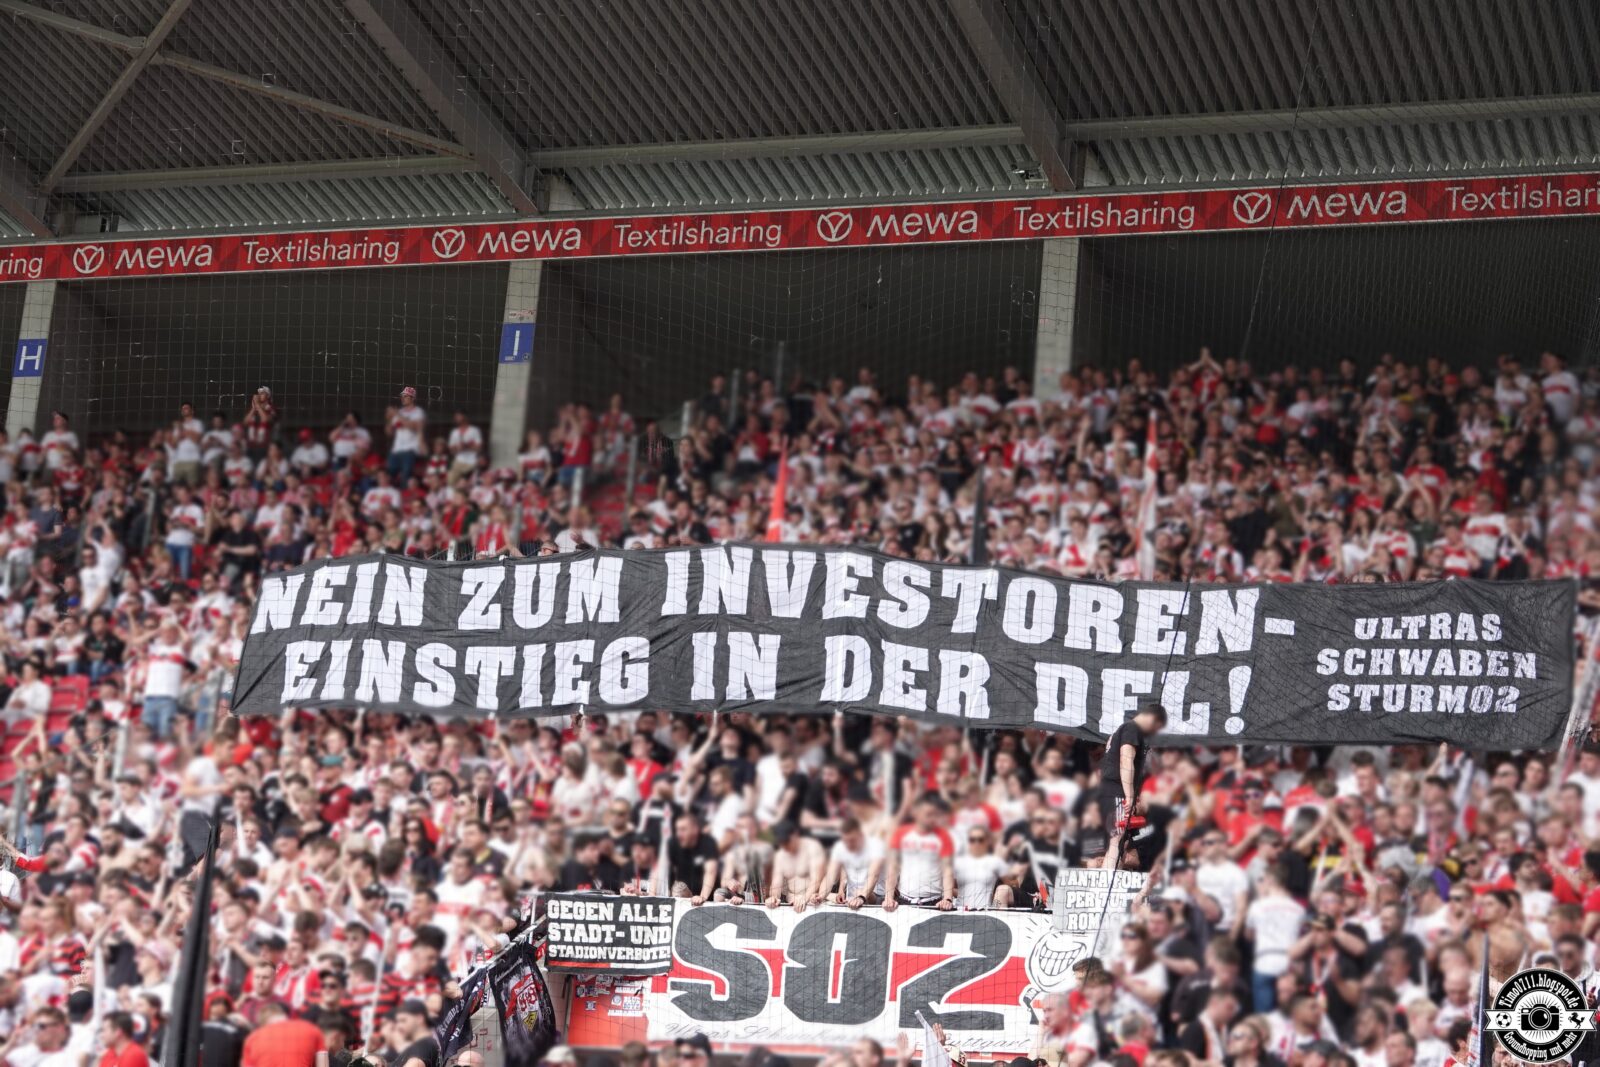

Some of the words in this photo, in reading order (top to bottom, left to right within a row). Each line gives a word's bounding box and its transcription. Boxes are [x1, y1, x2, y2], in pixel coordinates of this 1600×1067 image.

[243, 236, 399, 264] Textilsharing
[614, 219, 782, 248] Textilsharing
[1013, 200, 1195, 231] Textilsharing
[19, 345, 42, 370] H
[250, 561, 428, 635] NEIN
[457, 556, 624, 631] ZUM
[661, 546, 1295, 655] INVESTOREN-
[1354, 612, 1502, 642] ULTRAS
[1316, 648, 1537, 679] SCHWABEN
[280, 636, 651, 711] EINSTIEG
[690, 632, 781, 701] IN
[820, 634, 991, 720] DER
[1034, 665, 1252, 736] DFL!
[1059, 870, 1108, 888] TANTA
[547, 900, 614, 921] GEGEN
[619, 903, 672, 923] ALLE
[1066, 890, 1096, 909] PER
[548, 922, 626, 943] STADT-
[630, 925, 671, 945] UND
[548, 945, 671, 960] STADIONVERBOTE!
